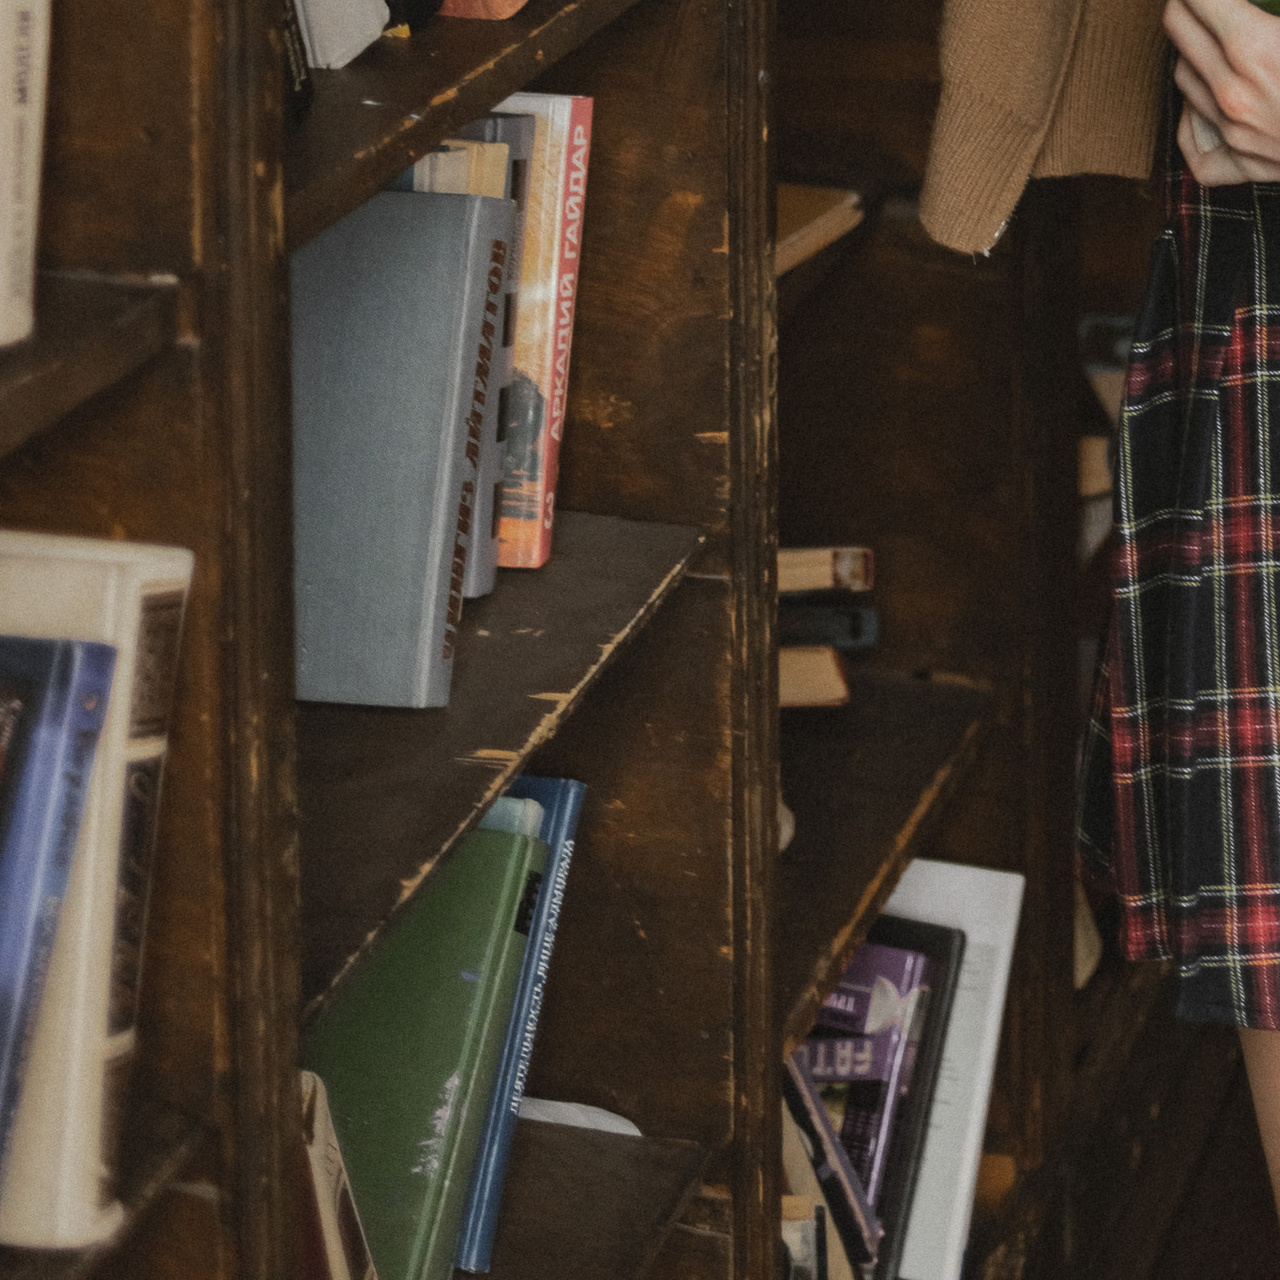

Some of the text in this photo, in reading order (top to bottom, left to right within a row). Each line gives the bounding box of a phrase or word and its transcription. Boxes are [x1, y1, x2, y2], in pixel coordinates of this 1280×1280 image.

[440, 238, 509, 662] ЧИНГИЗ АЙТМАТОВ
[549, 122, 587, 442] АРКАДИЙ ГАЙДАР
